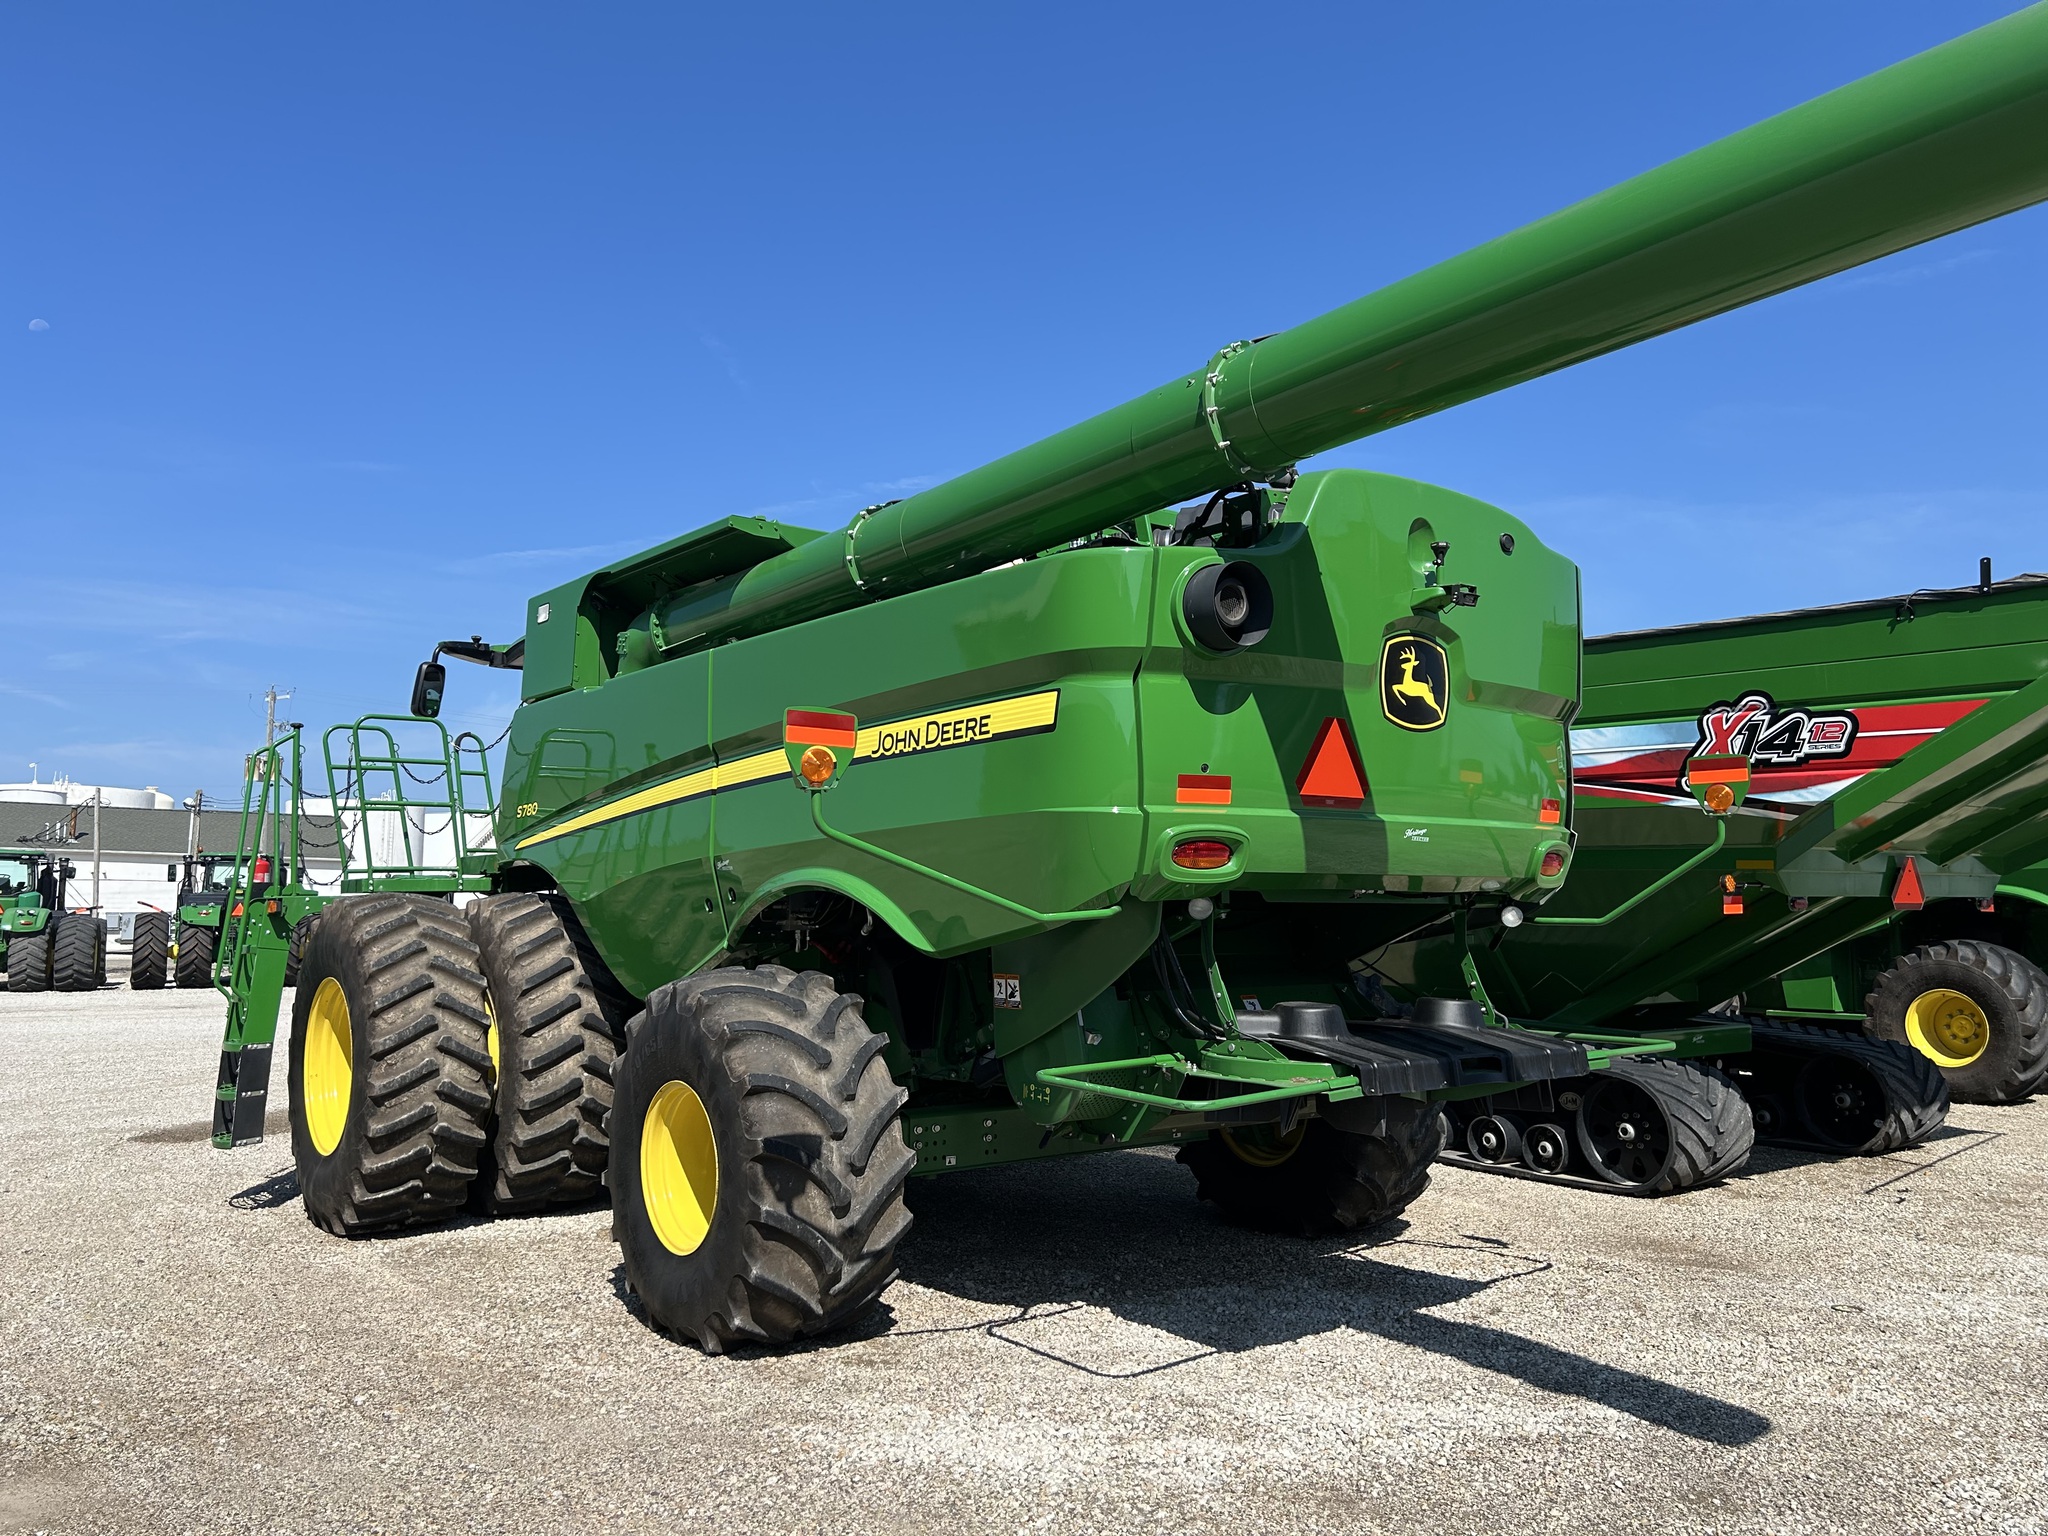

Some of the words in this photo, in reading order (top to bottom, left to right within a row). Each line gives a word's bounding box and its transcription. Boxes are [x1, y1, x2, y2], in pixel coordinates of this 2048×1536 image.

[871, 728, 921, 755] JOHN
[925, 714, 992, 746] DEERE
[1809, 722, 1847, 742] 12
[1807, 743, 1842, 751] SERIES
[516, 801, 539, 818] S780
